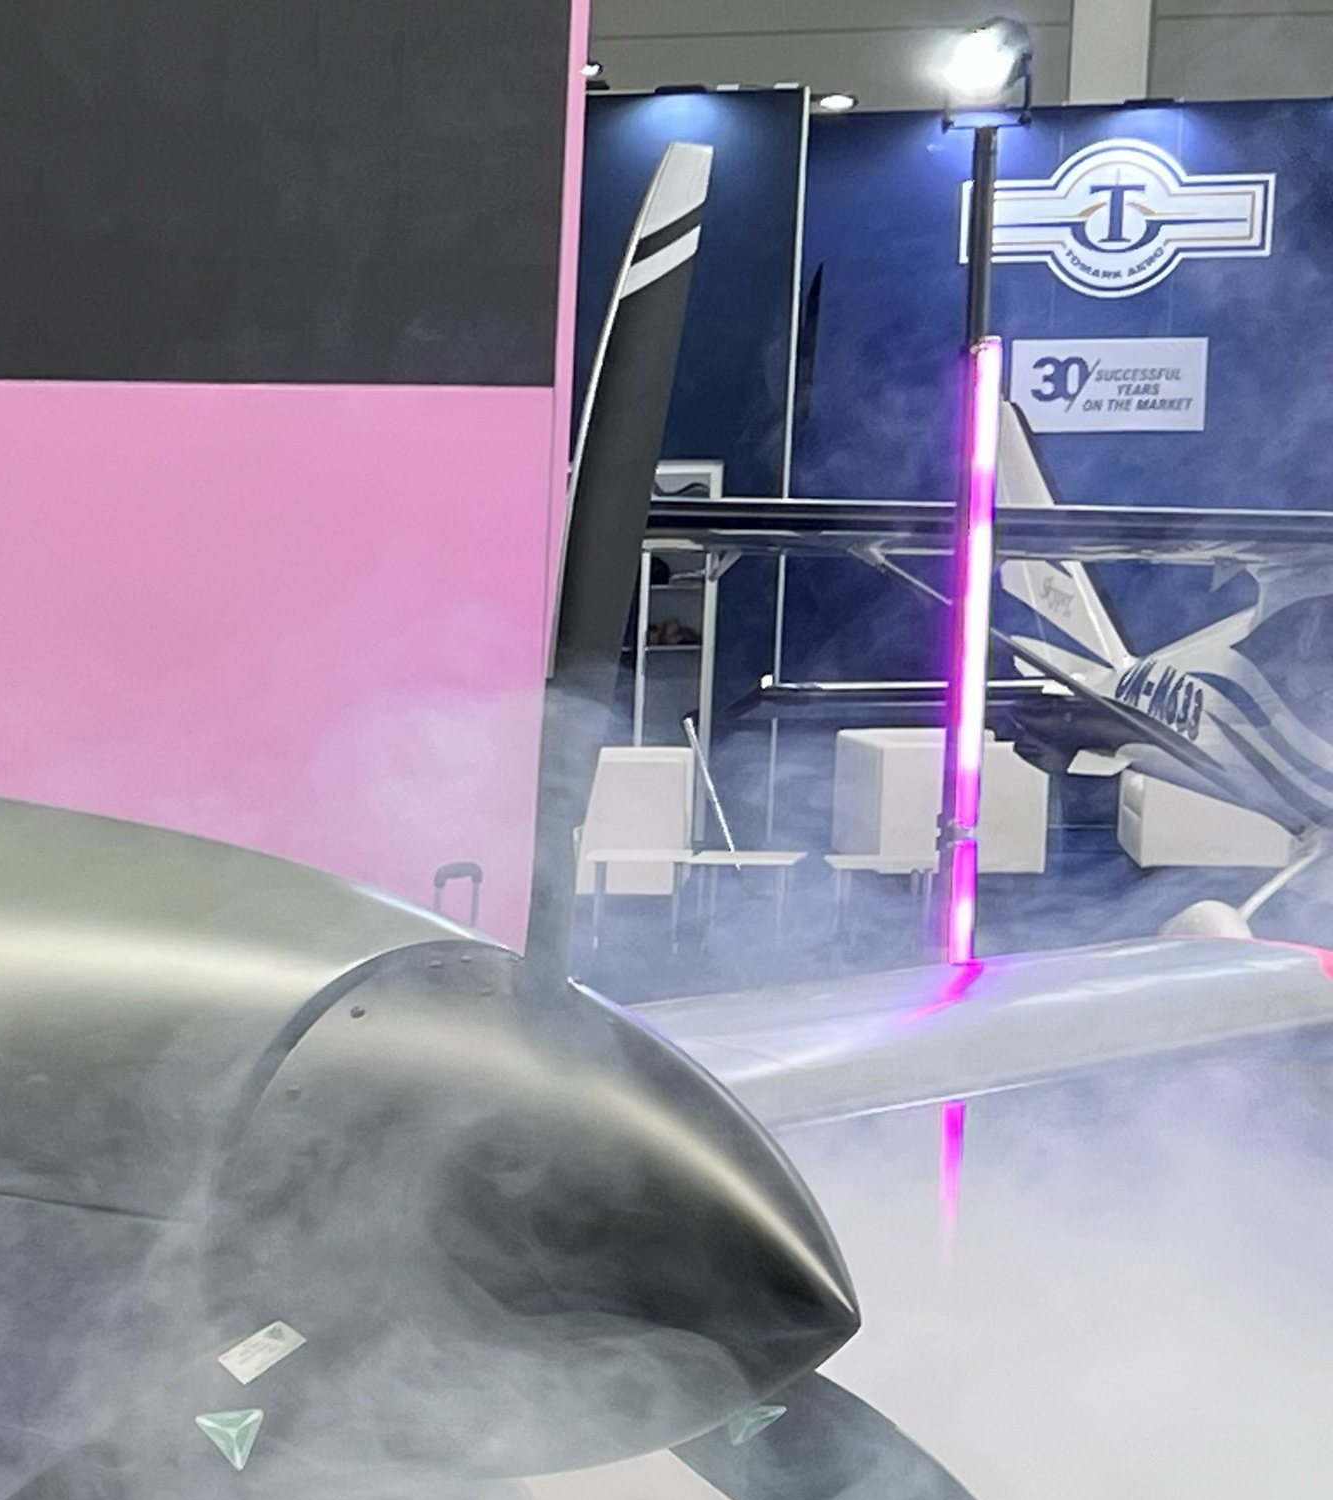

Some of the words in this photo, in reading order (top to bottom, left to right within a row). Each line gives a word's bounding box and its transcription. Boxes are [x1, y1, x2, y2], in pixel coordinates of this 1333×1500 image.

[1065, 249, 1123, 280] TOMARK
[1127, 247, 1164, 278] AERO
[1094, 367, 1182, 382] SUCCESSFUL
[1116, 383, 1161, 397] YEARS
[1082, 399, 1103, 412] ON
[1106, 398, 1132, 412] THE
[1135, 397, 1194, 412] MARKET
